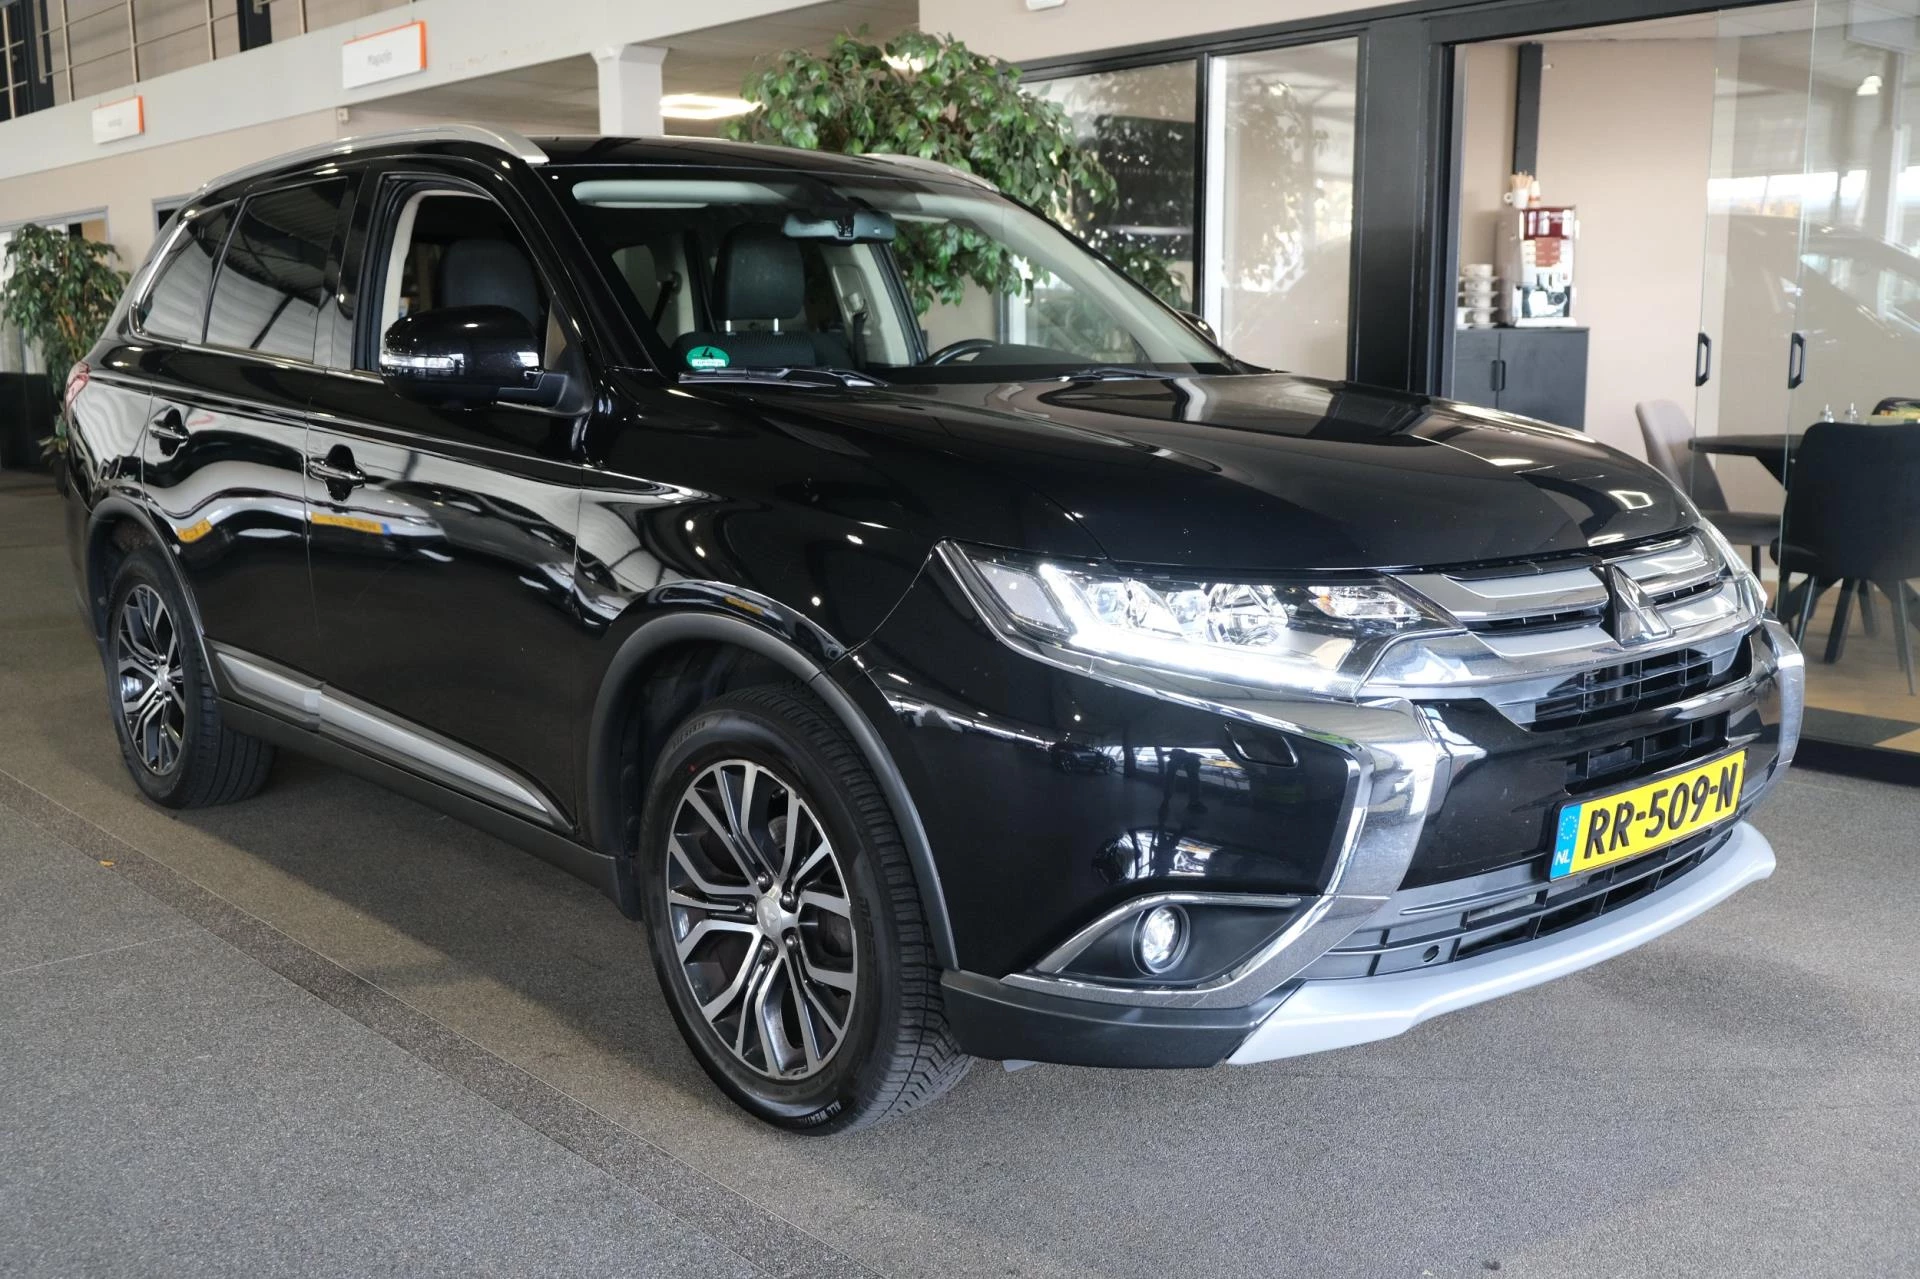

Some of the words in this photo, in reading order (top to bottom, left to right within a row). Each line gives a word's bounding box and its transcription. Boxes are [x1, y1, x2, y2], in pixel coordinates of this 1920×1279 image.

[702, 347, 714, 359] 4
[1584, 762, 1738, 860] RR-509-N
[1555, 849, 1571, 866] NL
[826, 1100, 842, 1115] ALL
